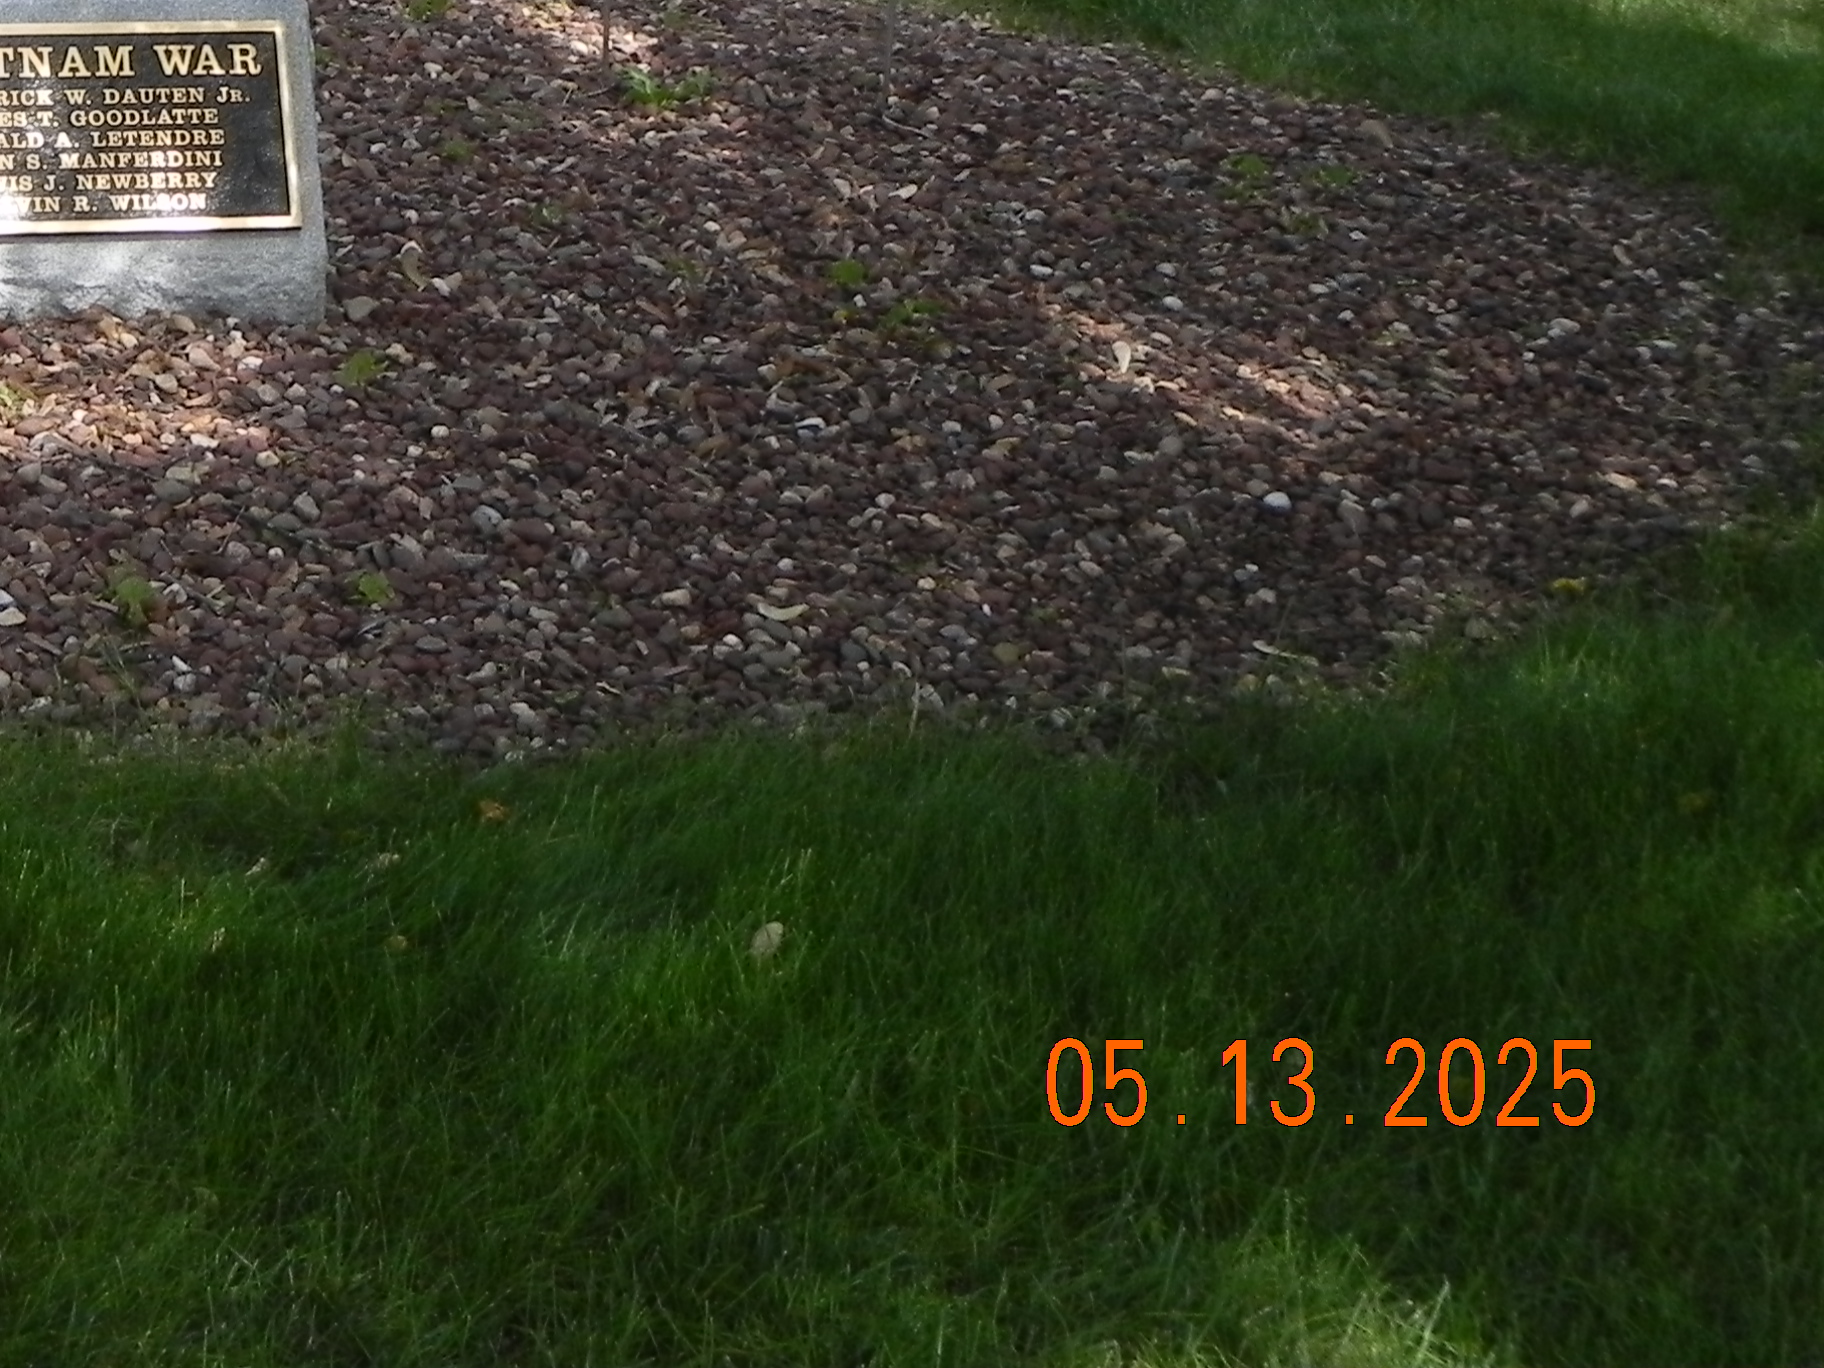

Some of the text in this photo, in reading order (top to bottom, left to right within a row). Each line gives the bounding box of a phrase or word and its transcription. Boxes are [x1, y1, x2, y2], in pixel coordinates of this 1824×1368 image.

[152, 42, 263, 78] WAR
[64, 89, 91, 106] W.
[103, 86, 206, 105] DAUTEN
[34, 110, 59, 128] T.
[70, 108, 219, 128] GOODLATTE
[53, 131, 80, 149] A.
[91, 129, 225, 148] LETENDRE
[26, 153, 48, 170] S.
[59, 150, 223, 170] MANFERDINI
[43, 174, 64, 192] J.
[76, 172, 218, 191] NEWBERRY
[72, 195, 98, 213] R.
[108, 193, 208, 213] WILSON
